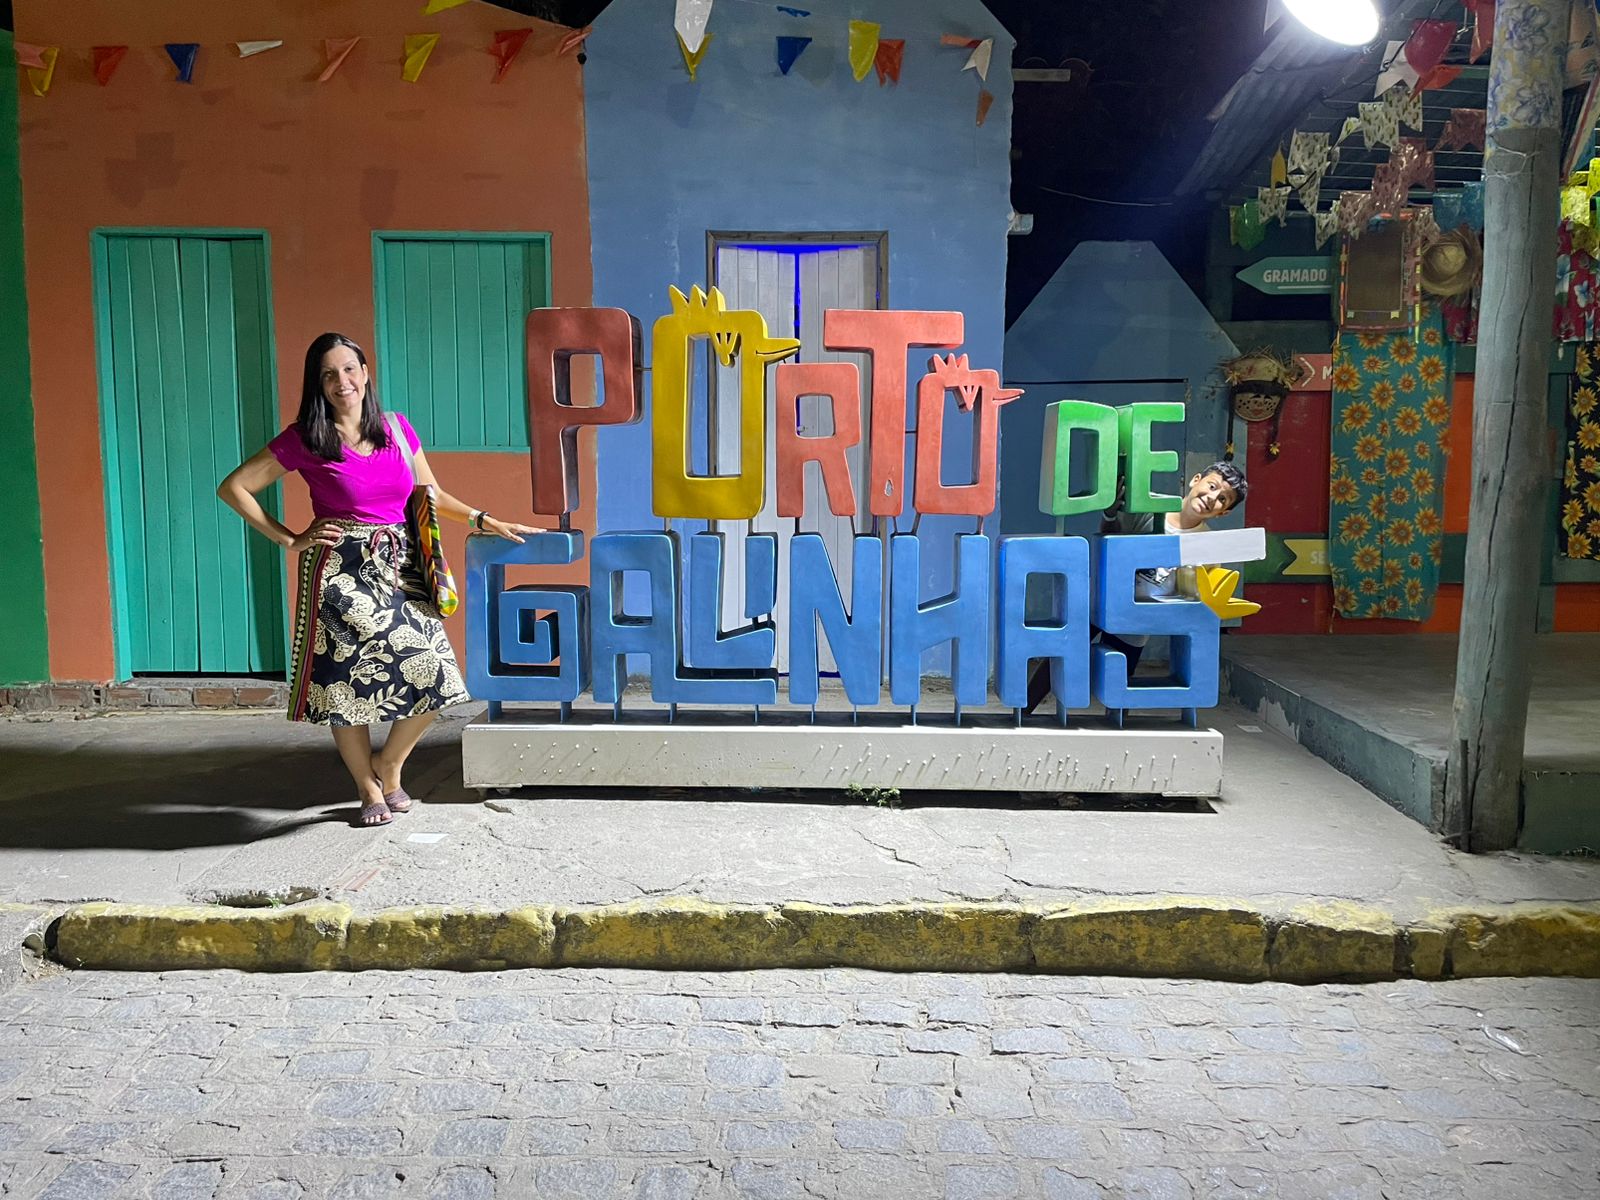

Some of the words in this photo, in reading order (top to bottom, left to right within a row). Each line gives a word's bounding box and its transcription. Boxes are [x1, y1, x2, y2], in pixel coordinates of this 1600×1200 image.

[1263, 269, 1327, 283] GRAMADO
[526, 285, 1024, 520] PORTO
[1038, 400, 1187, 516] DE
[465, 529, 1266, 711] GALINHAS
